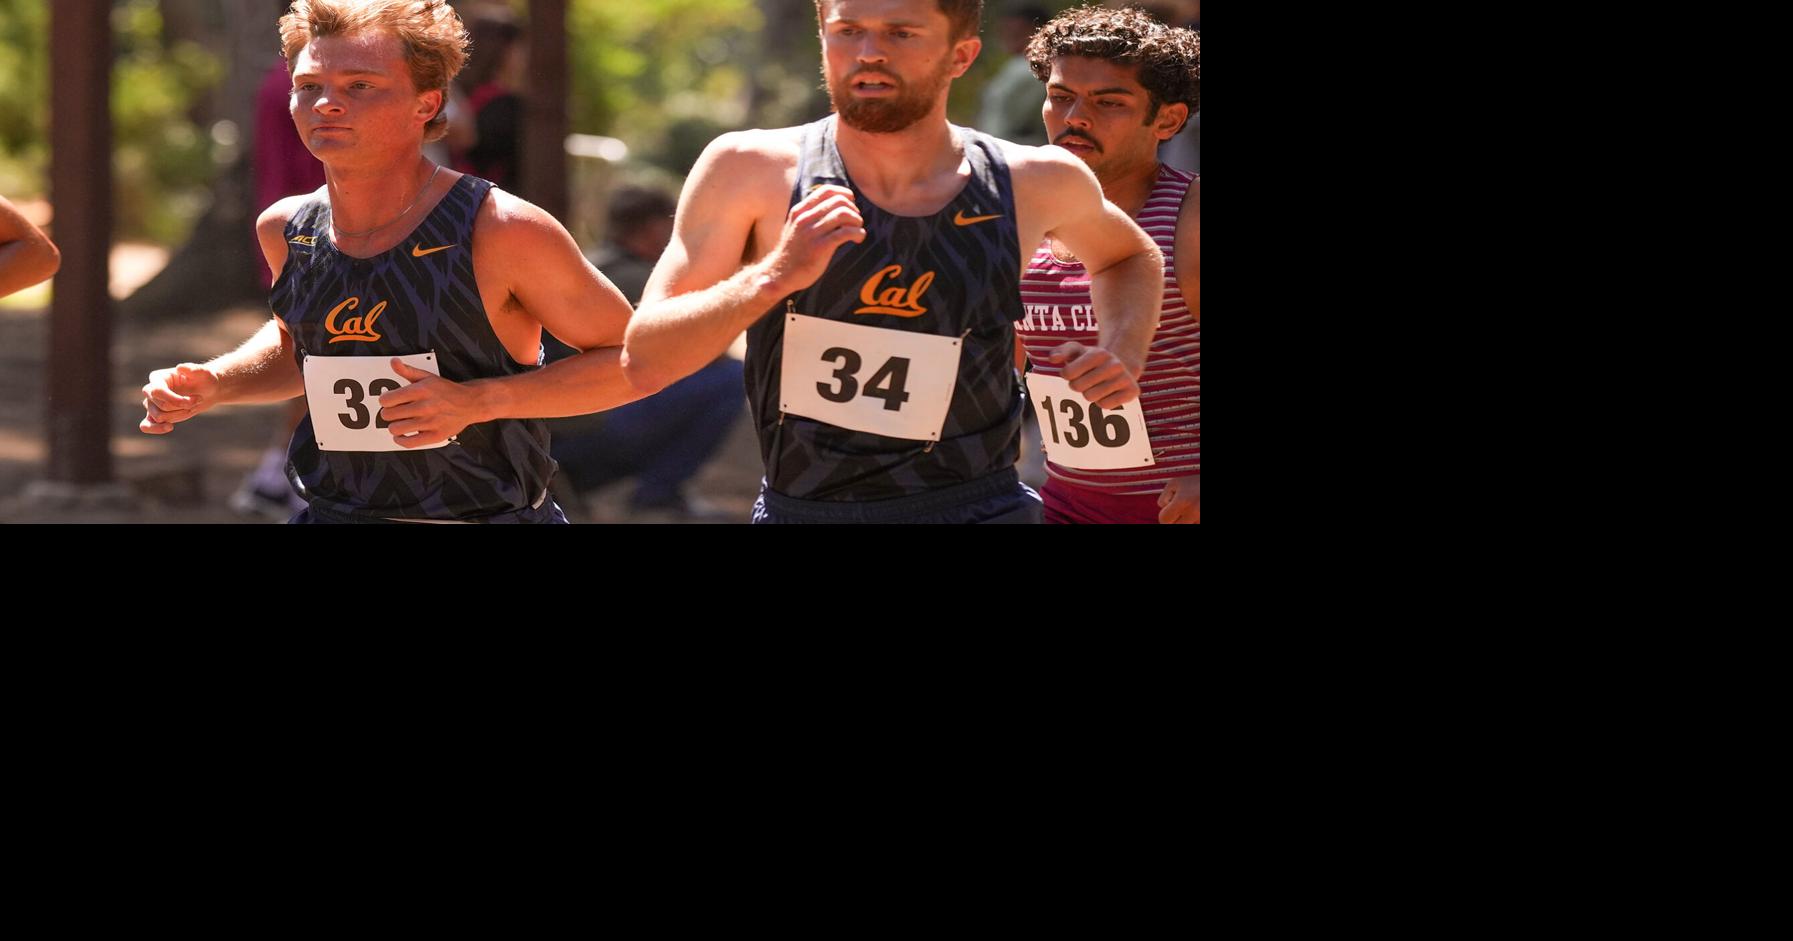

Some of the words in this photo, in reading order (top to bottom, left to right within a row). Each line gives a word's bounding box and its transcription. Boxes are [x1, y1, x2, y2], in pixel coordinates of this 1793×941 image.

[853, 264, 935, 318] Cal
[1013, 305, 1066, 331] NTA
[324, 296, 387, 344] Cal
[816, 346, 911, 412] 34
[1041, 395, 1131, 449] 136
